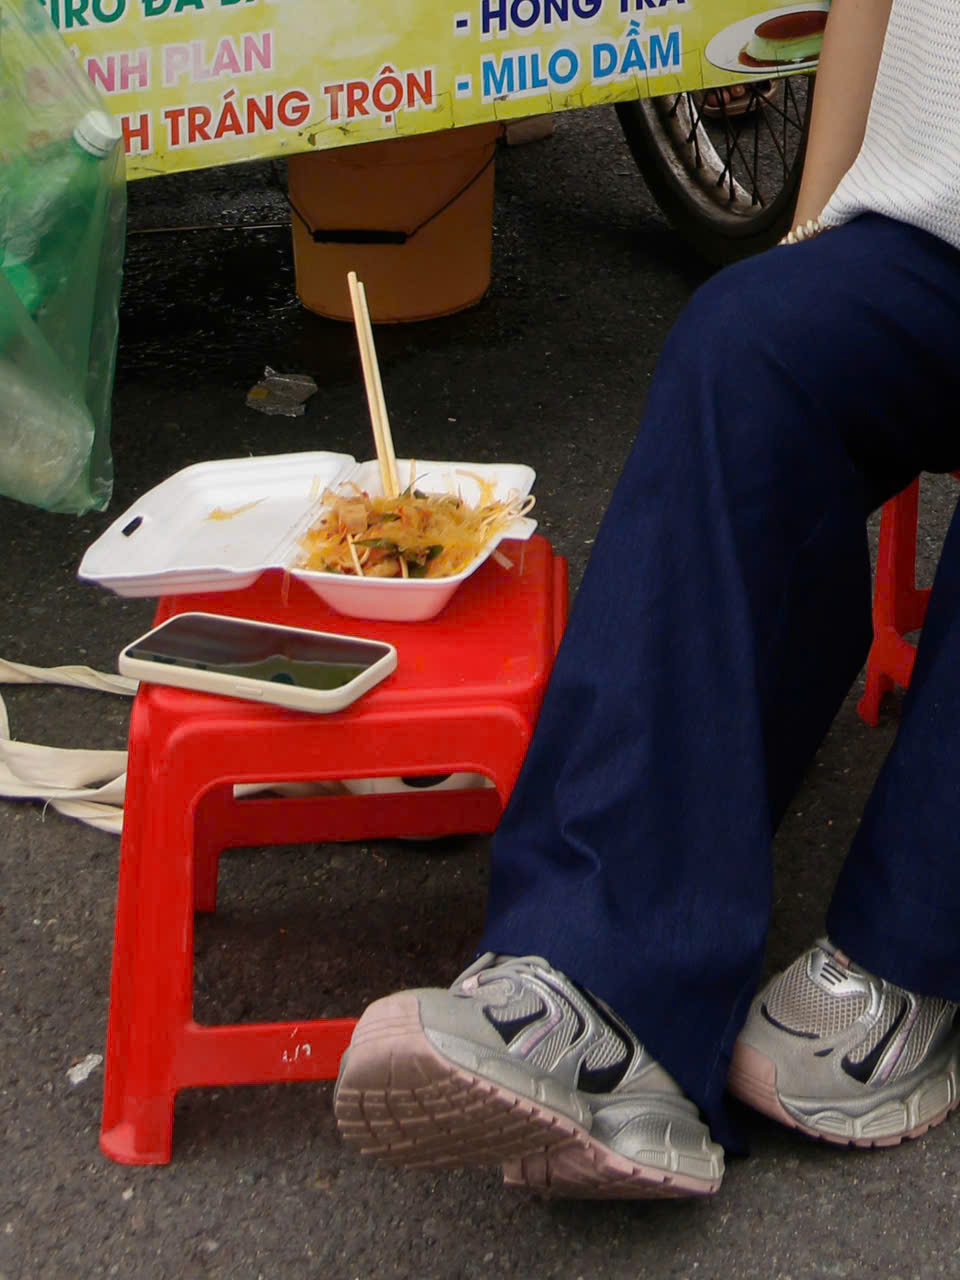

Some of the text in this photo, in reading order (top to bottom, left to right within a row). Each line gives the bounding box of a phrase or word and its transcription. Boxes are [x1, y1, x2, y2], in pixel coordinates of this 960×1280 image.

[164, 32, 272, 82] PLAN
[482, 48, 579, 97] MILO
[593, 19, 680, 79] DẦM
[166, 87, 310, 146] TRÁNG
[325, 64, 434, 123] TRỘN
